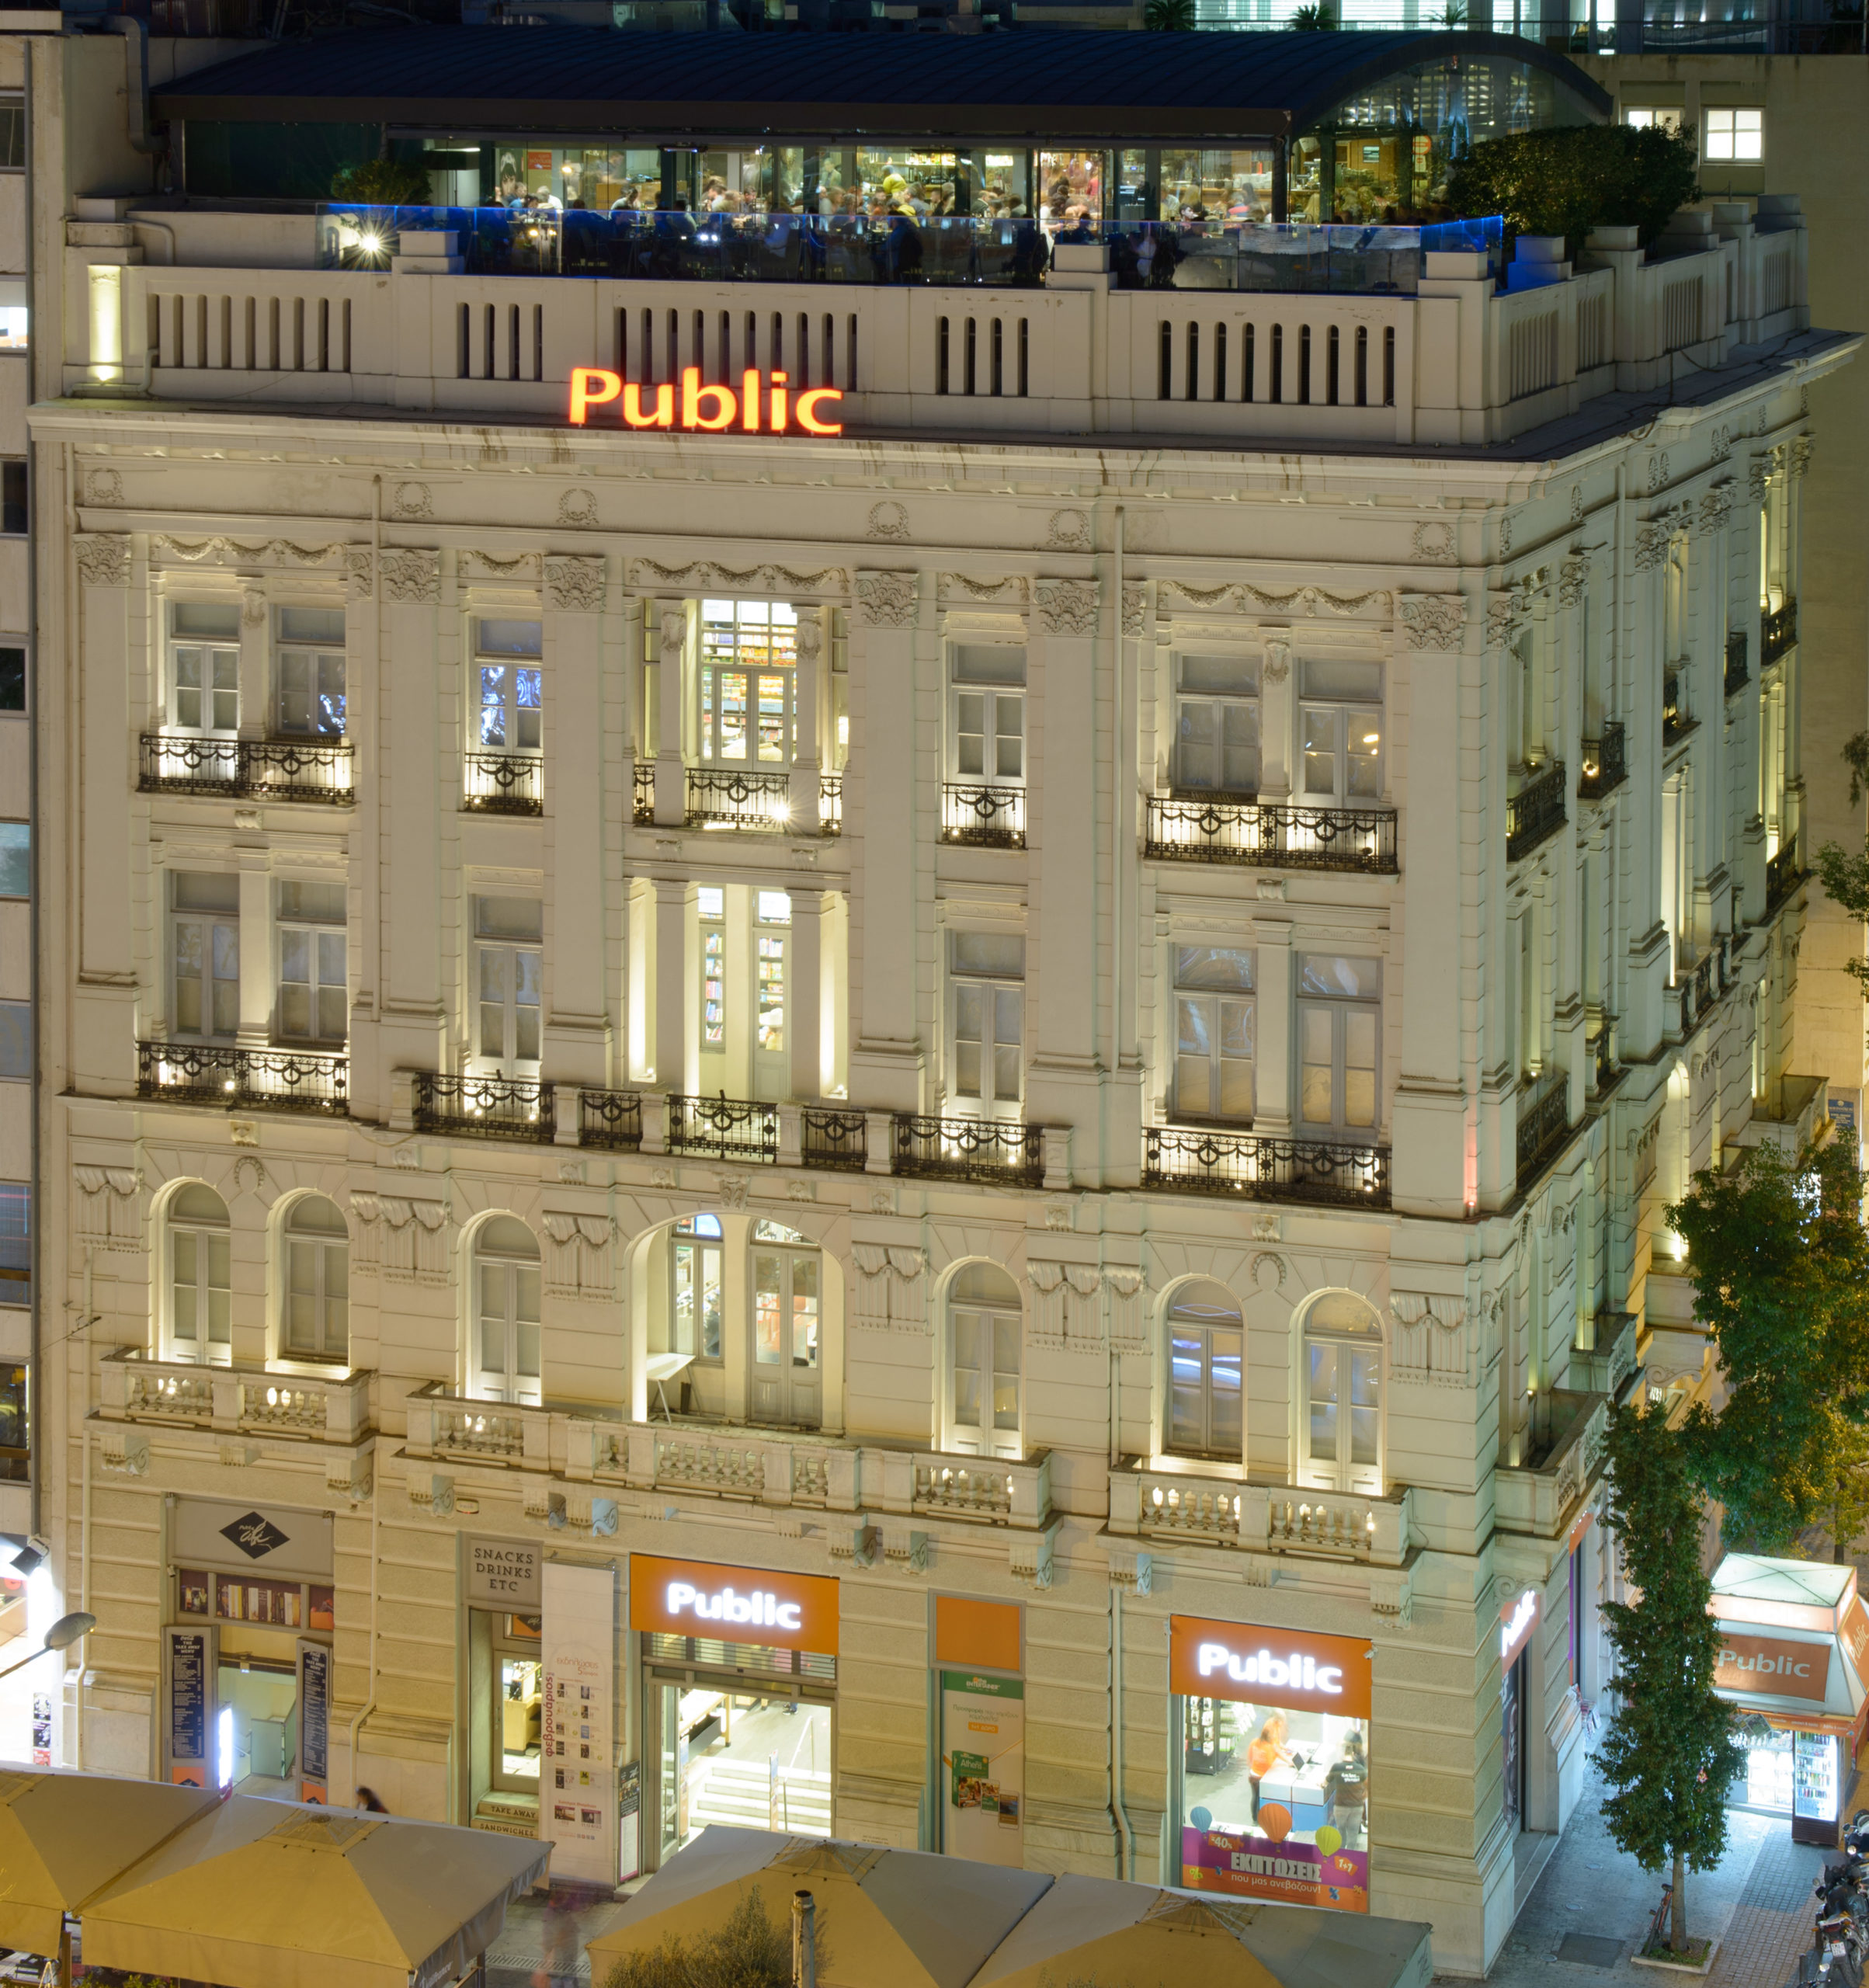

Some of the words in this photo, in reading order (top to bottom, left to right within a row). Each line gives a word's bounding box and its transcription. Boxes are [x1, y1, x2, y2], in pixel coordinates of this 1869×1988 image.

[569, 367, 844, 435] Public
[474, 1547, 533, 1565] SNACKS
[475, 1562, 532, 1579] DRINKS
[489, 1579, 518, 1592] ETC
[667, 1581, 802, 1630] Public
[1501, 1589, 1536, 1657] Public
[1198, 1642, 1343, 1694] Public
[1717, 1649, 1811, 1678] Public
[543, 1676, 555, 1757] φεβρουάριος
[491, 1806, 511, 1815] TAKE
[513, 1809, 536, 1819] AWAY
[479, 1823, 535, 1837] SANDWICHES
[1231, 1852, 1322, 1883] ΕΚΠΤΩΣΕΙΣ
[1338, 1858, 1353, 1873] 1+1
[1231, 1873, 1249, 1882] που
[1251, 1876, 1268, 1886] μας
[1270, 1879, 1321, 1894] ανεβάζουν!
